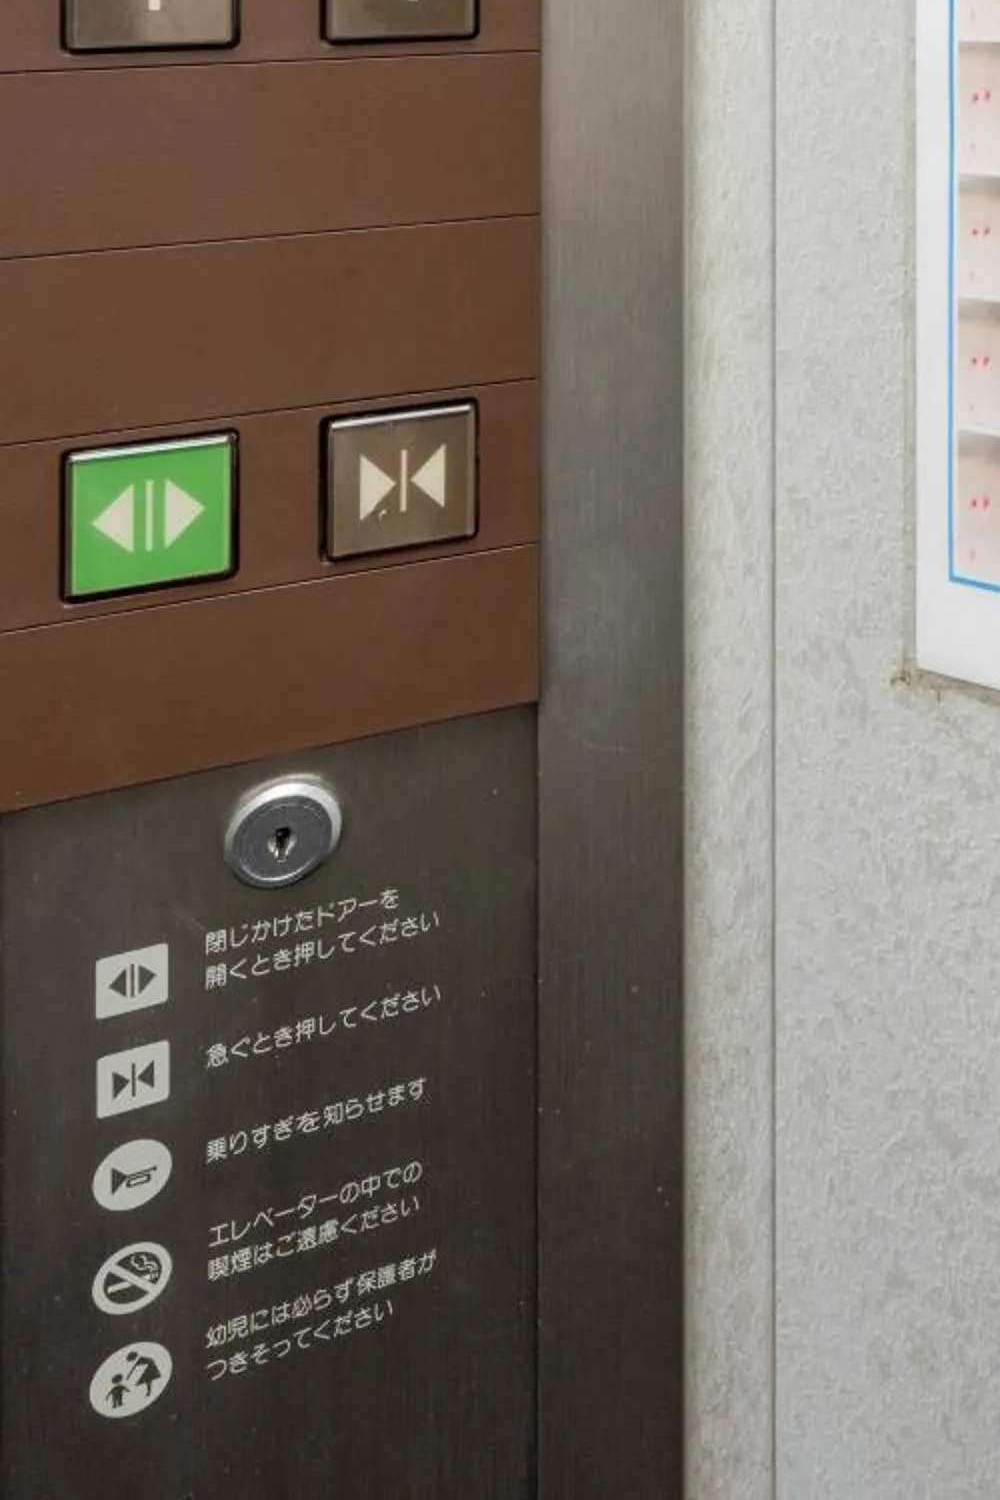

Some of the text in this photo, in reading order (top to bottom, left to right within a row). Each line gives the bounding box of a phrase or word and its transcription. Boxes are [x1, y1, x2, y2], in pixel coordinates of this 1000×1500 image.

[205, 888, 400, 956] 閉じかけたドアーを
[205, 911, 440, 990] 開くとき押してください
[206, 984, 442, 1069] 急ぐとき押してください
[205, 1077, 427, 1164] 乗りすぎを知らせます
[207, 1196, 421, 1282] 喫煙はご遠慮ください
[208, 1160, 424, 1248] エレベーターの中での
[206, 1299, 394, 1381] つきそってください
